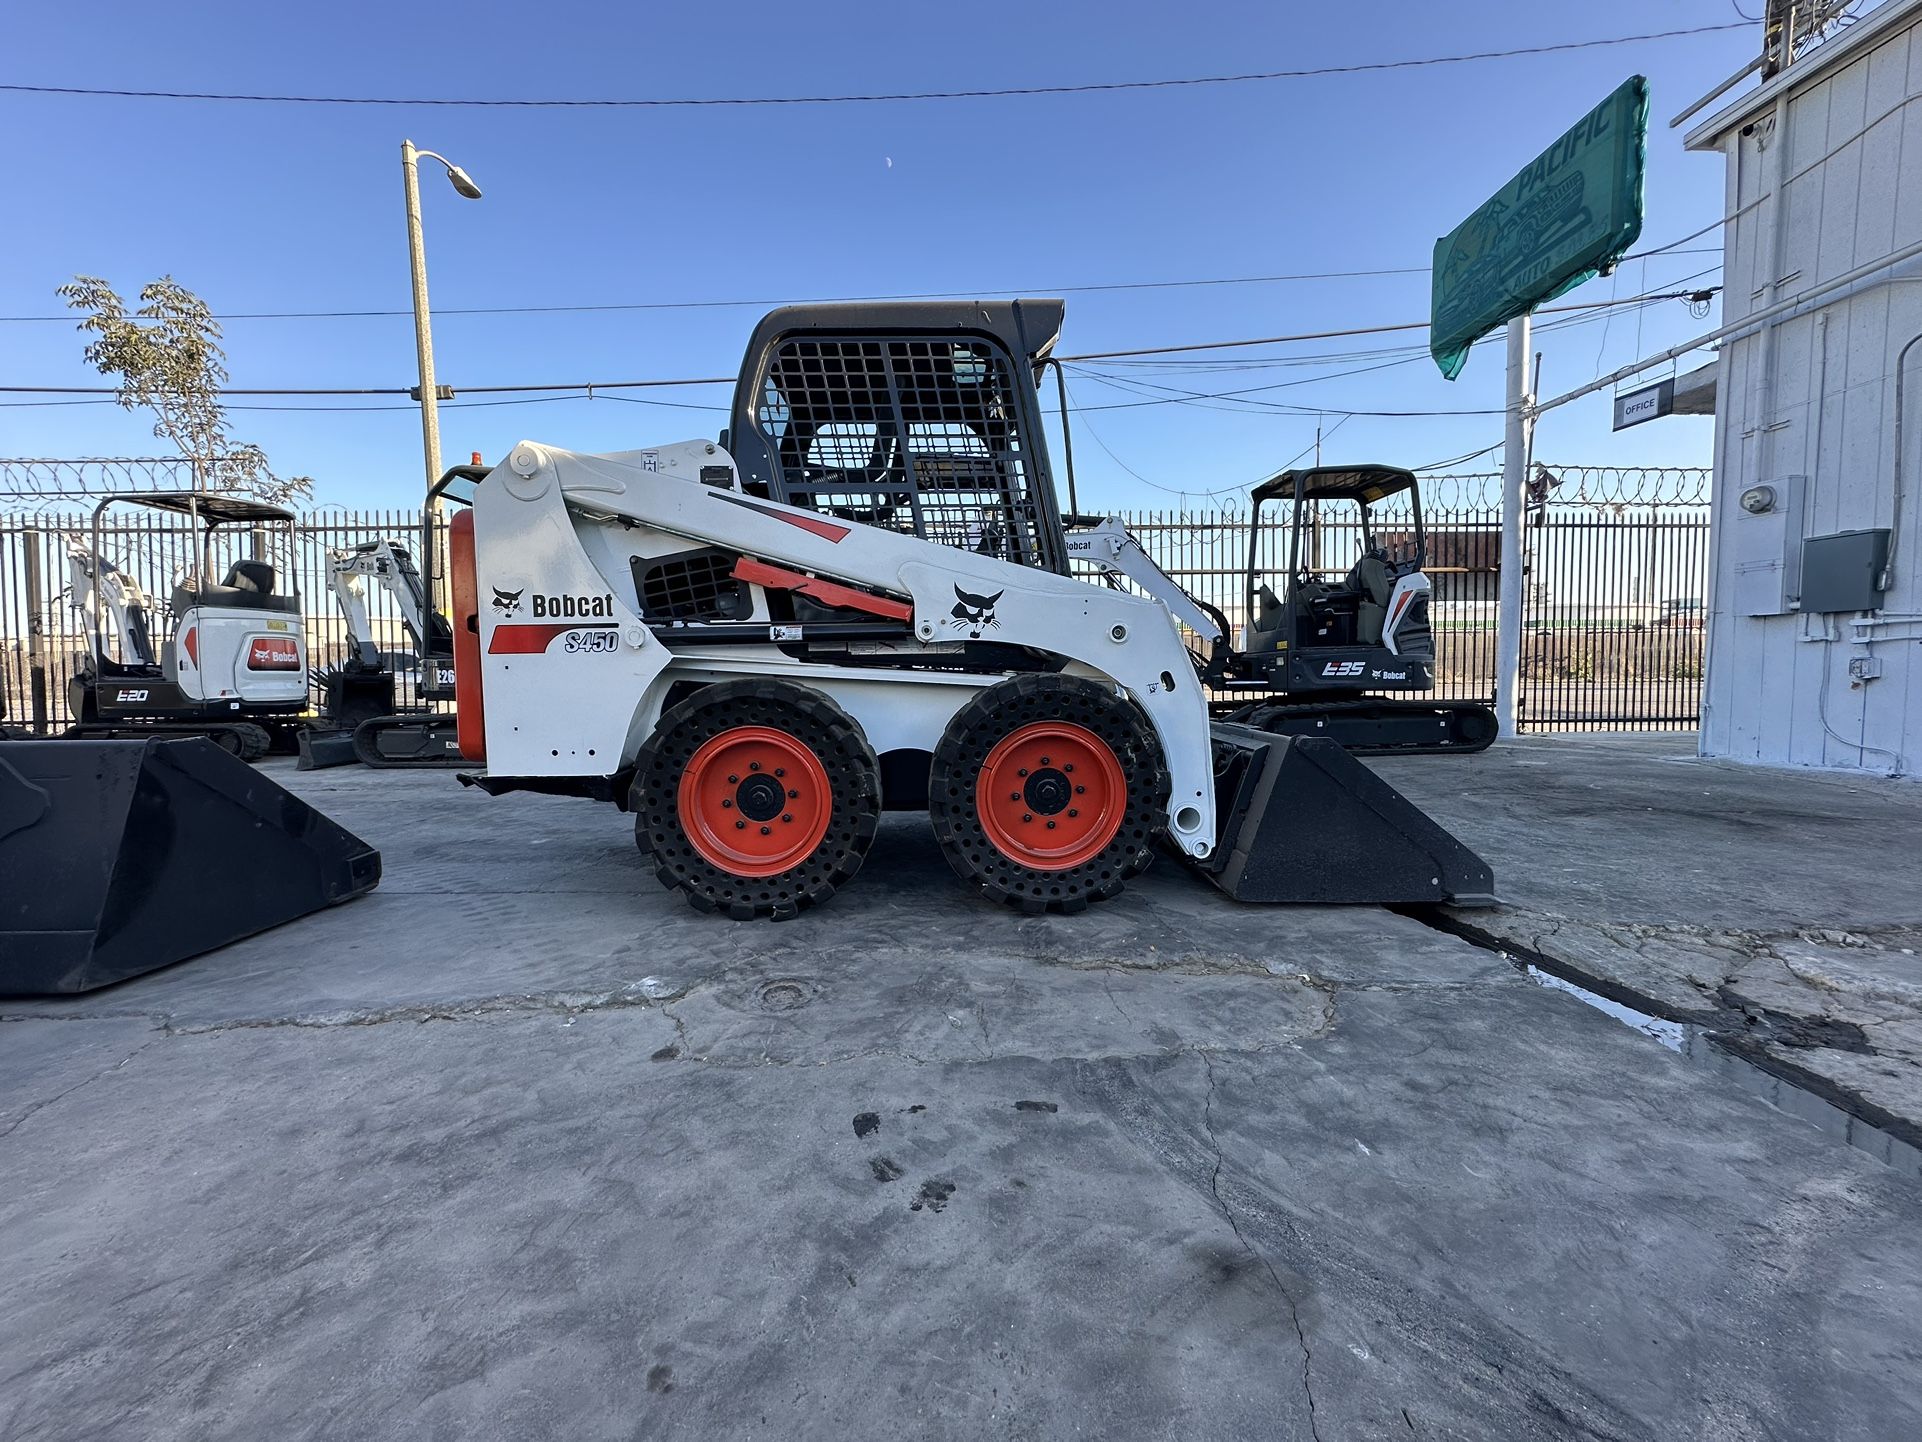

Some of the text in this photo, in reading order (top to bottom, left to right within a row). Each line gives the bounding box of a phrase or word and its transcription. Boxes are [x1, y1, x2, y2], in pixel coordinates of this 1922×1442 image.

[1515, 97, 1612, 201] PACIFIC
[1512, 256, 1550, 291] AUTO
[1625, 398, 1655, 415] OFFICE
[532, 593, 614, 618] Bobcat
[564, 631, 620, 653] S450
[272, 651, 298, 663] Bobcat
[436, 669, 455, 684] E26
[1321, 661, 1366, 676] E35
[1382, 671, 1406, 680] Bobcat
[116, 689, 149, 702] E20
